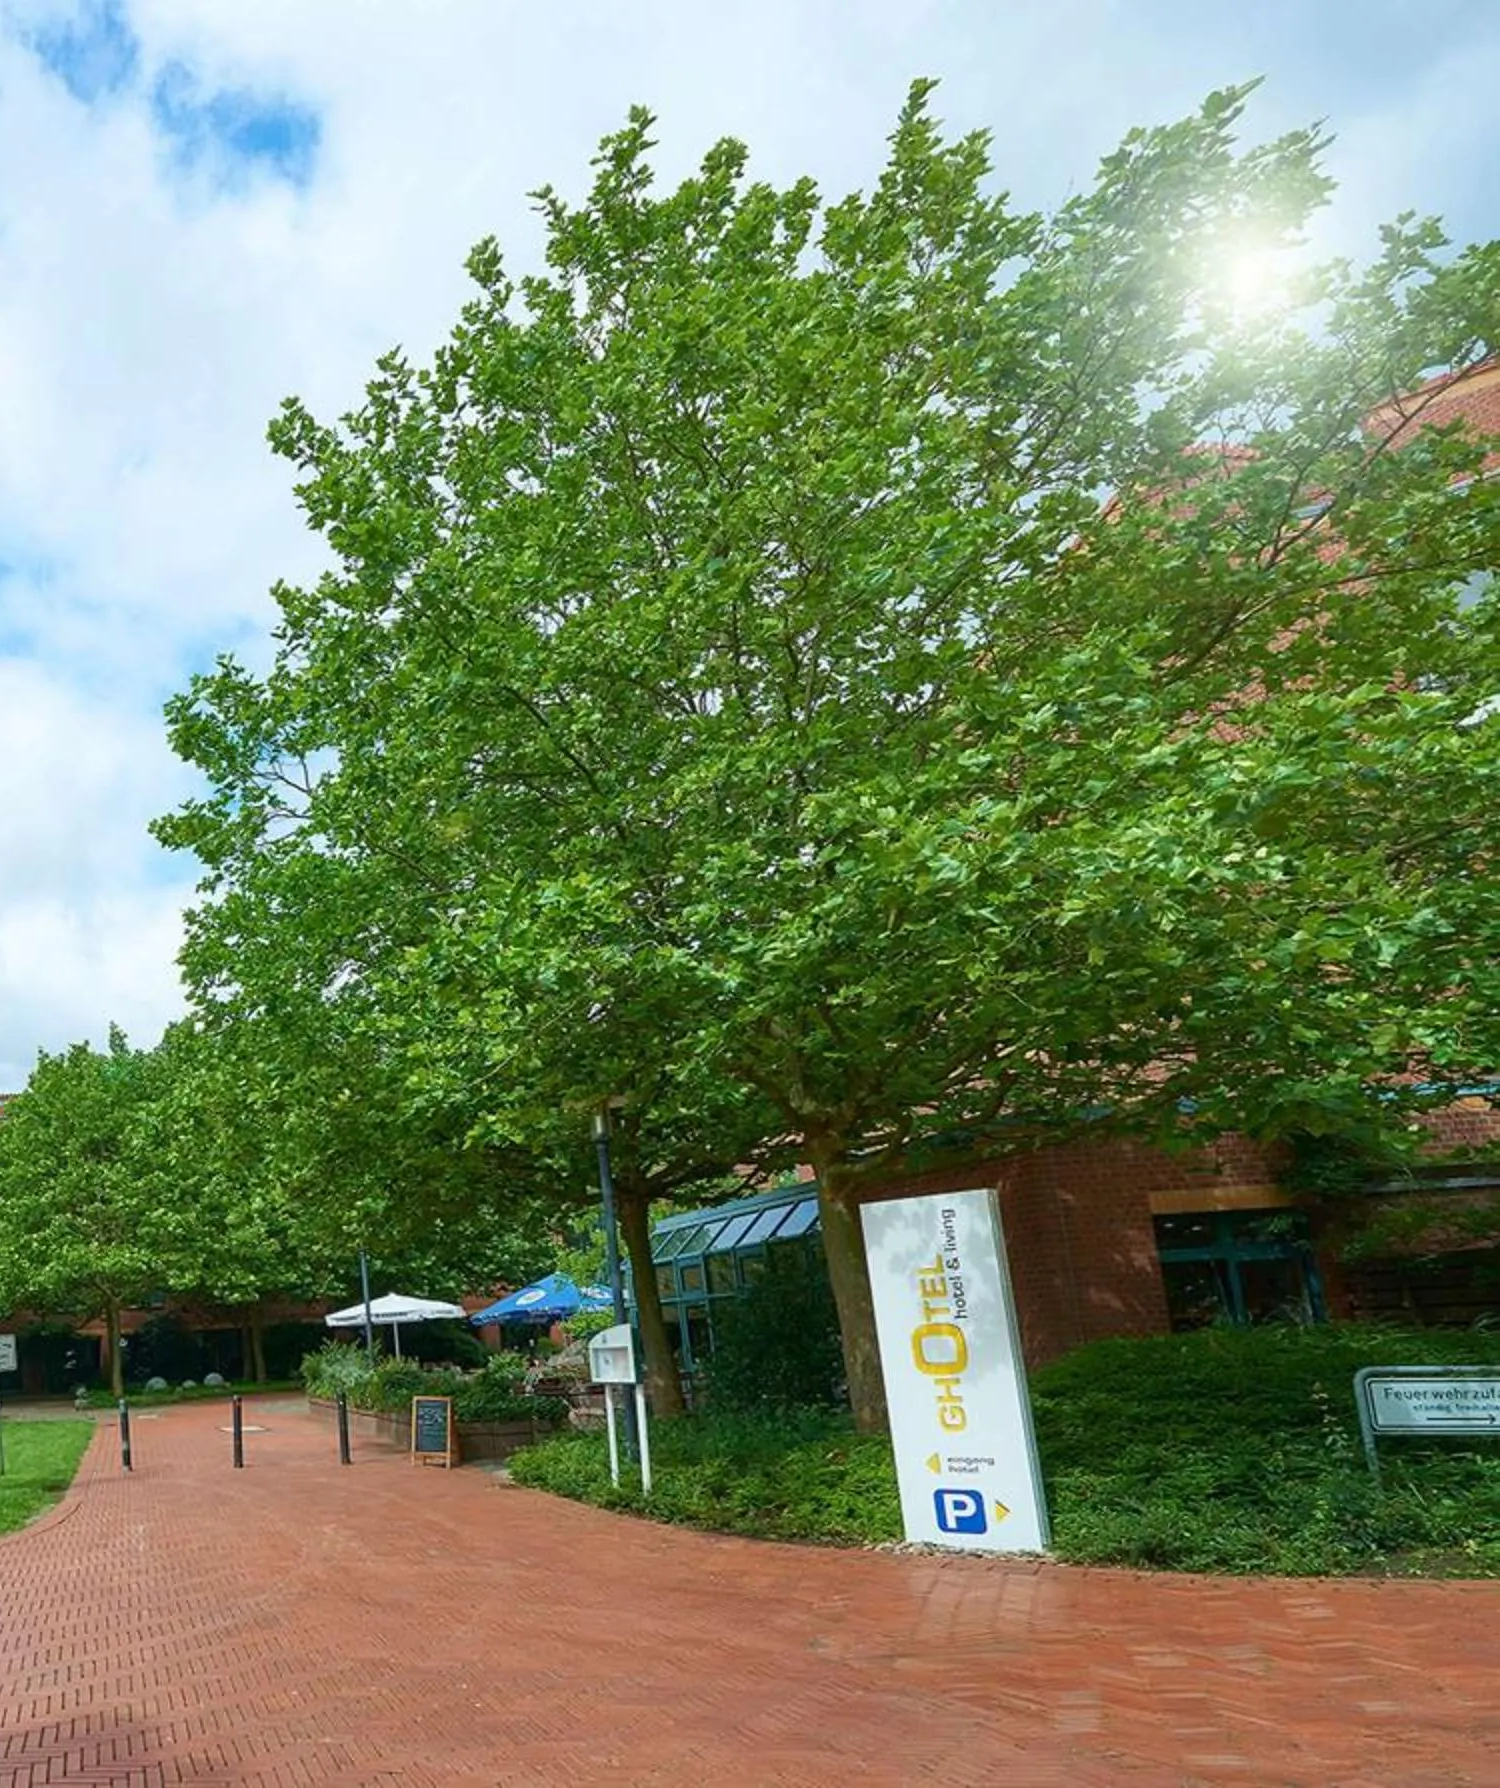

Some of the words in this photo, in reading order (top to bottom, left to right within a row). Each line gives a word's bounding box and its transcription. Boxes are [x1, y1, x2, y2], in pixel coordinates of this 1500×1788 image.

[940, 1209, 957, 1252] living
[946, 1258, 960, 1270] &
[948, 1276, 967, 1319] hotel
[911, 1253, 968, 1433] GHOTEL
[1384, 1387, 1500, 1400] Feuerwehrzuf
[943, 1493, 977, 1528] P
